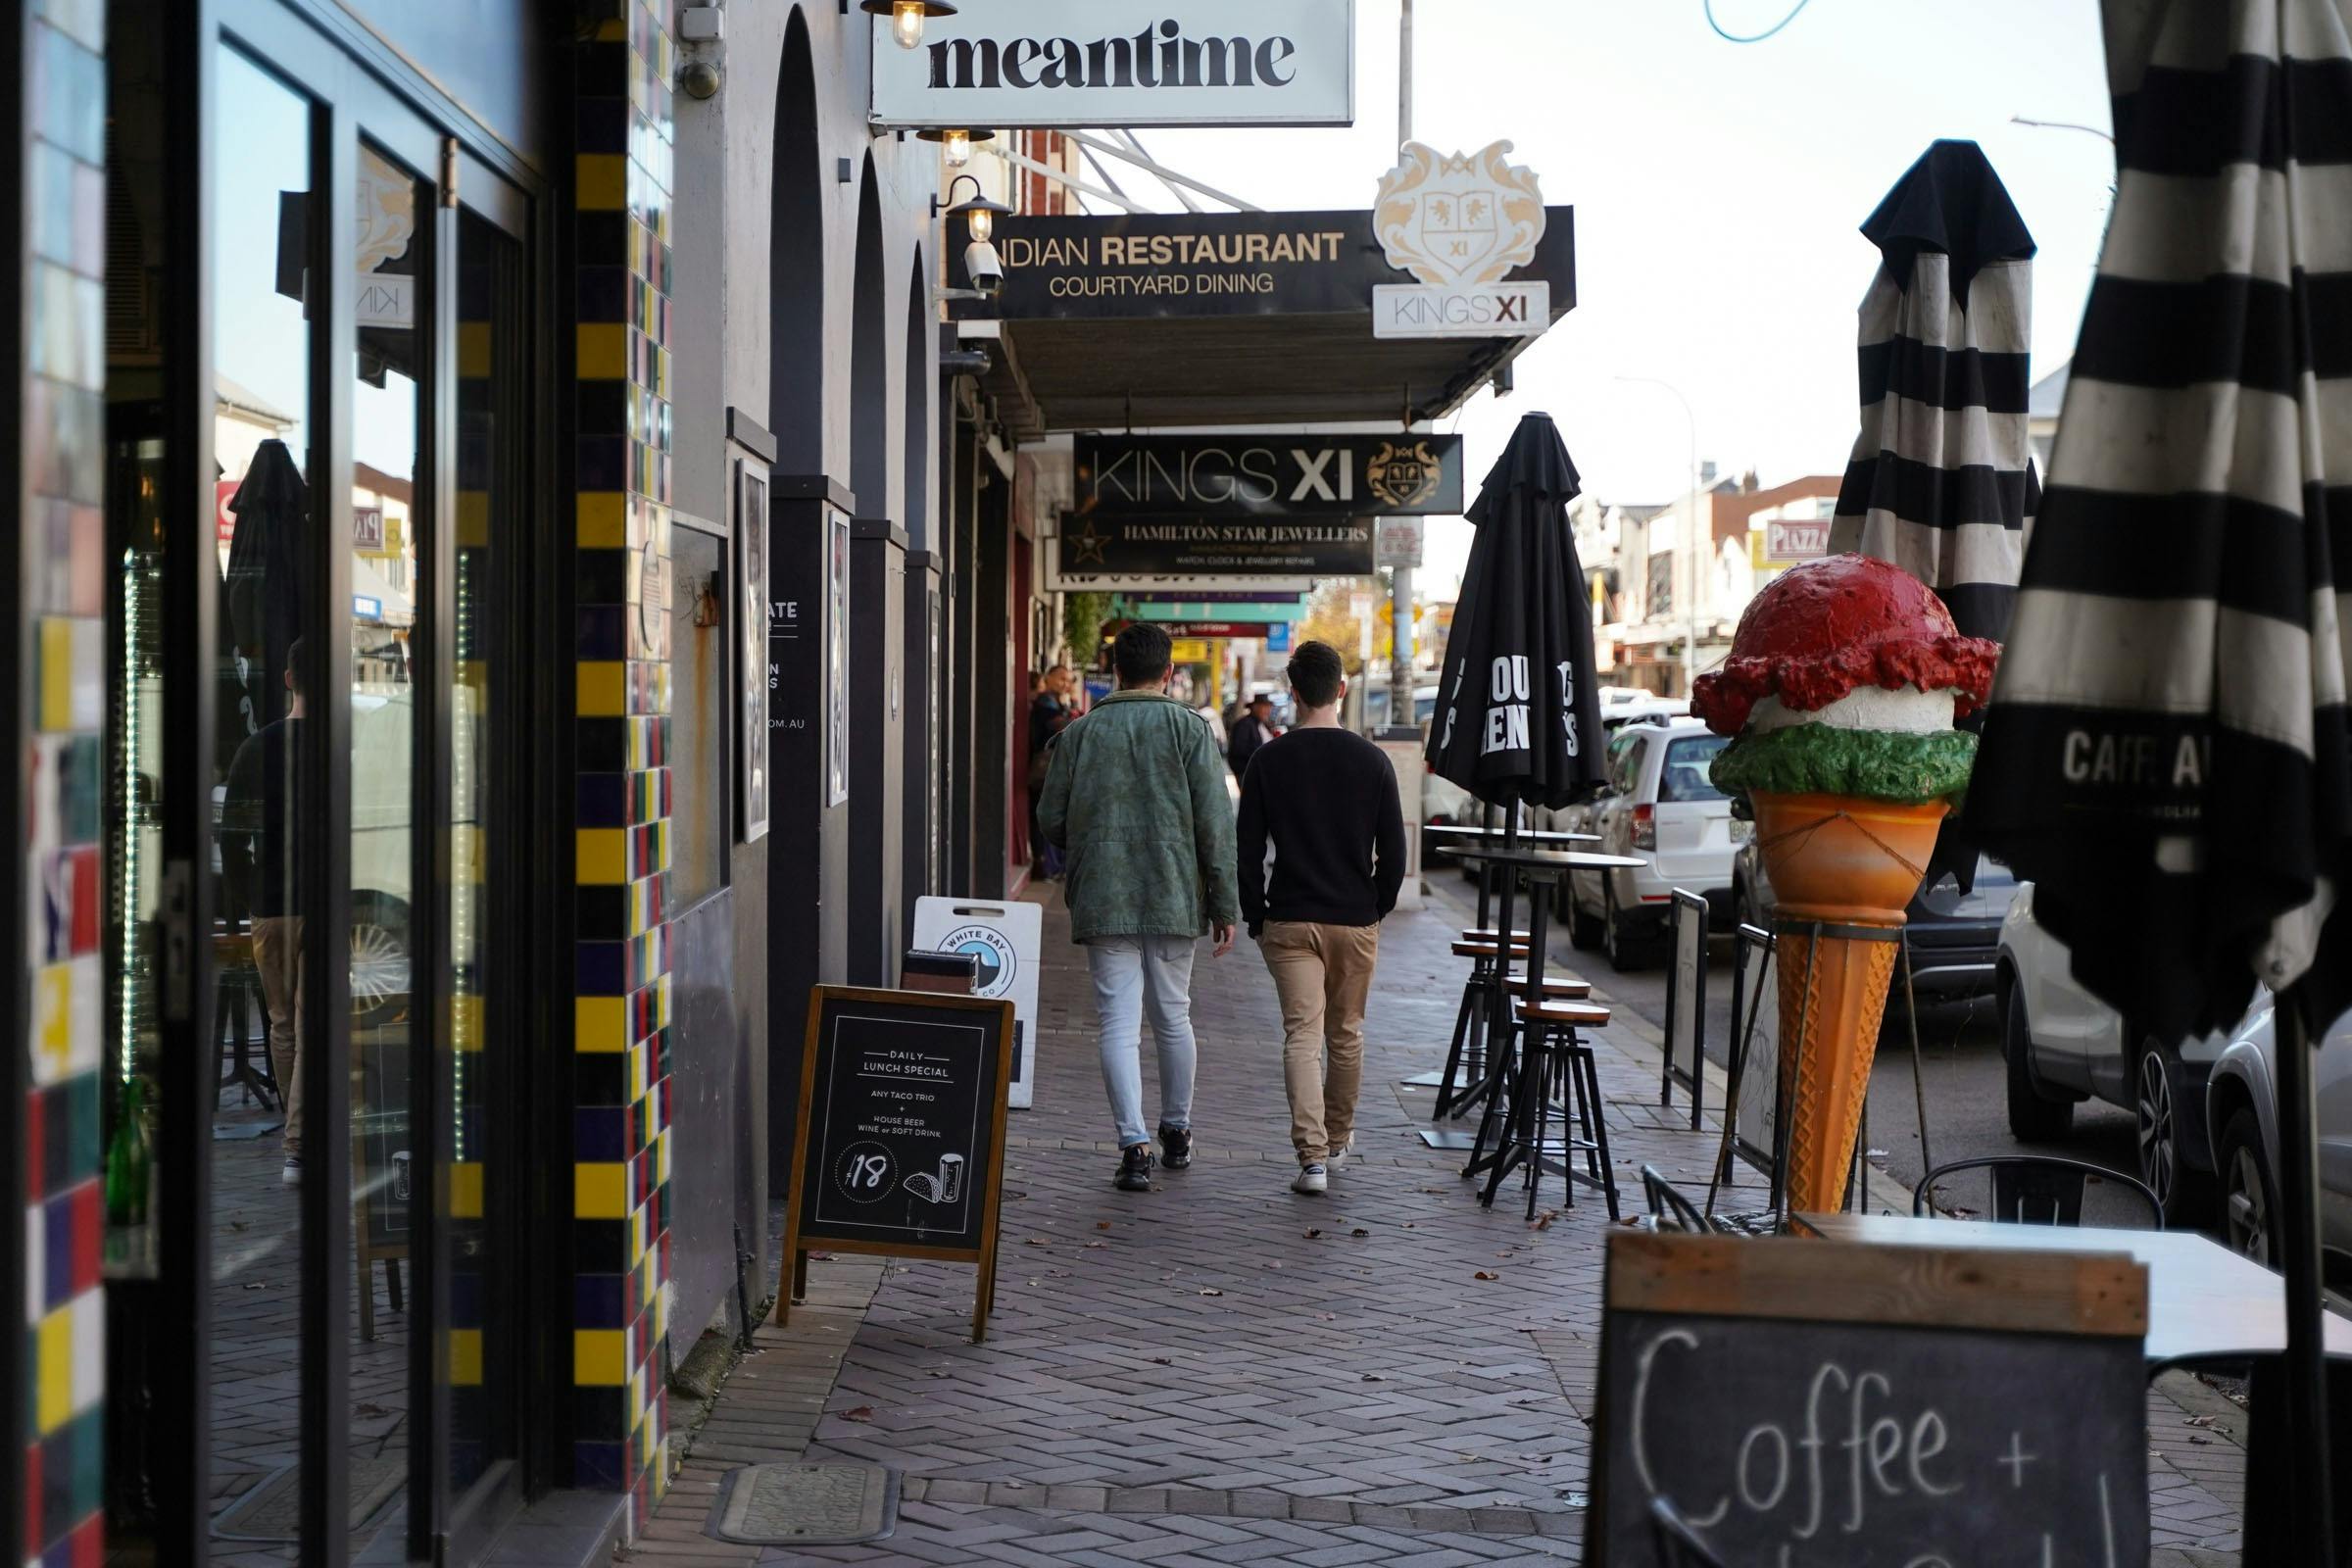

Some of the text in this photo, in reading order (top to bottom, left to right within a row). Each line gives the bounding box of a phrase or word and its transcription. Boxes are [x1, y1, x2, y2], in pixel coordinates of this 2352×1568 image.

[926, 19, 1297, 89] meantime
[996, 231, 1345, 268] NDIAN RESTAURANT
[1449, 240, 1468, 257] XI
[1050, 273, 1274, 297] COURTYARD DINING
[1395, 295, 1527, 324] KINGS XI
[1093, 448, 1353, 503] KINGS XI
[1123, 525, 1217, 541] HAMILTON
[1222, 525, 1267, 541] STAR
[1269, 525, 1369, 543] JEWELLERS
[767, 602, 798, 618] ATE
[768, 718, 805, 728] OM.AU
[947, 930, 1006, 951] WHITE BAY
[890, 1050, 923, 1060] DAILY
[863, 1061, 949, 1077] LUNCH SPECIAL
[871, 1090, 889, 1099] ANY
[890, 1092, 913, 1101] TACO
[873, 1115, 902, 1125] HOUSE
[858, 1124, 879, 1133] WINE
[914, 1129, 941, 1138] DRINK
[1633, 1329, 1964, 1539] Coffee
